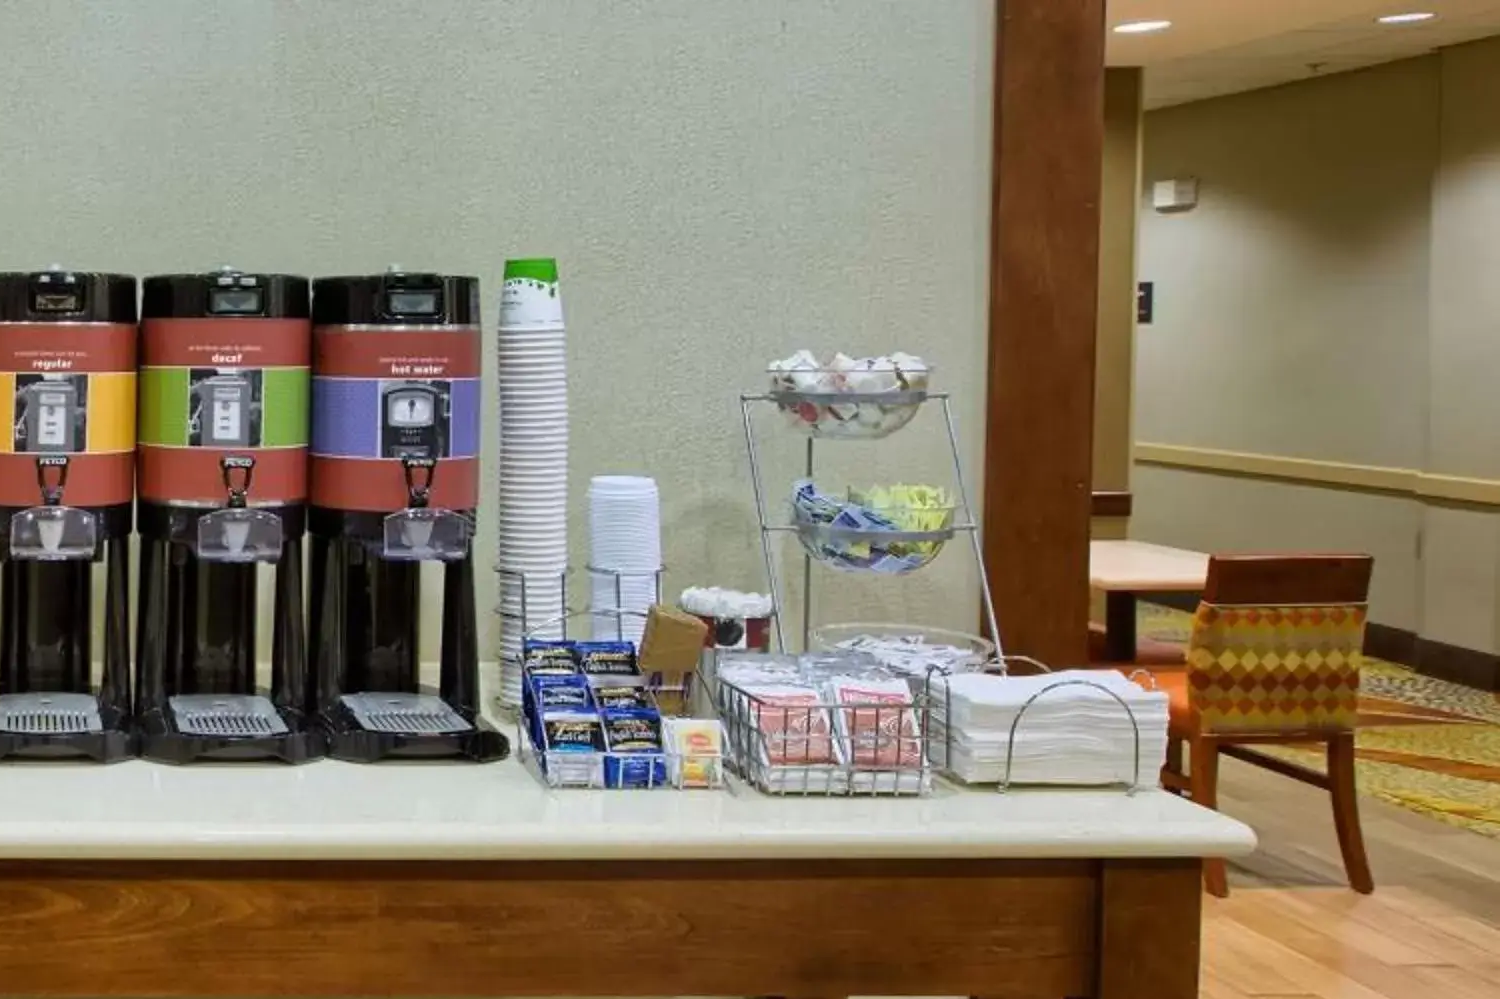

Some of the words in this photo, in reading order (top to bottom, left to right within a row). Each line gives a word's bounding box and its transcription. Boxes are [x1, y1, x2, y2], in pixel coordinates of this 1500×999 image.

[32, 358, 73, 370] regular
[211, 353, 243, 363] decaf
[391, 363, 411, 375] hot
[413, 364, 444, 375] water
